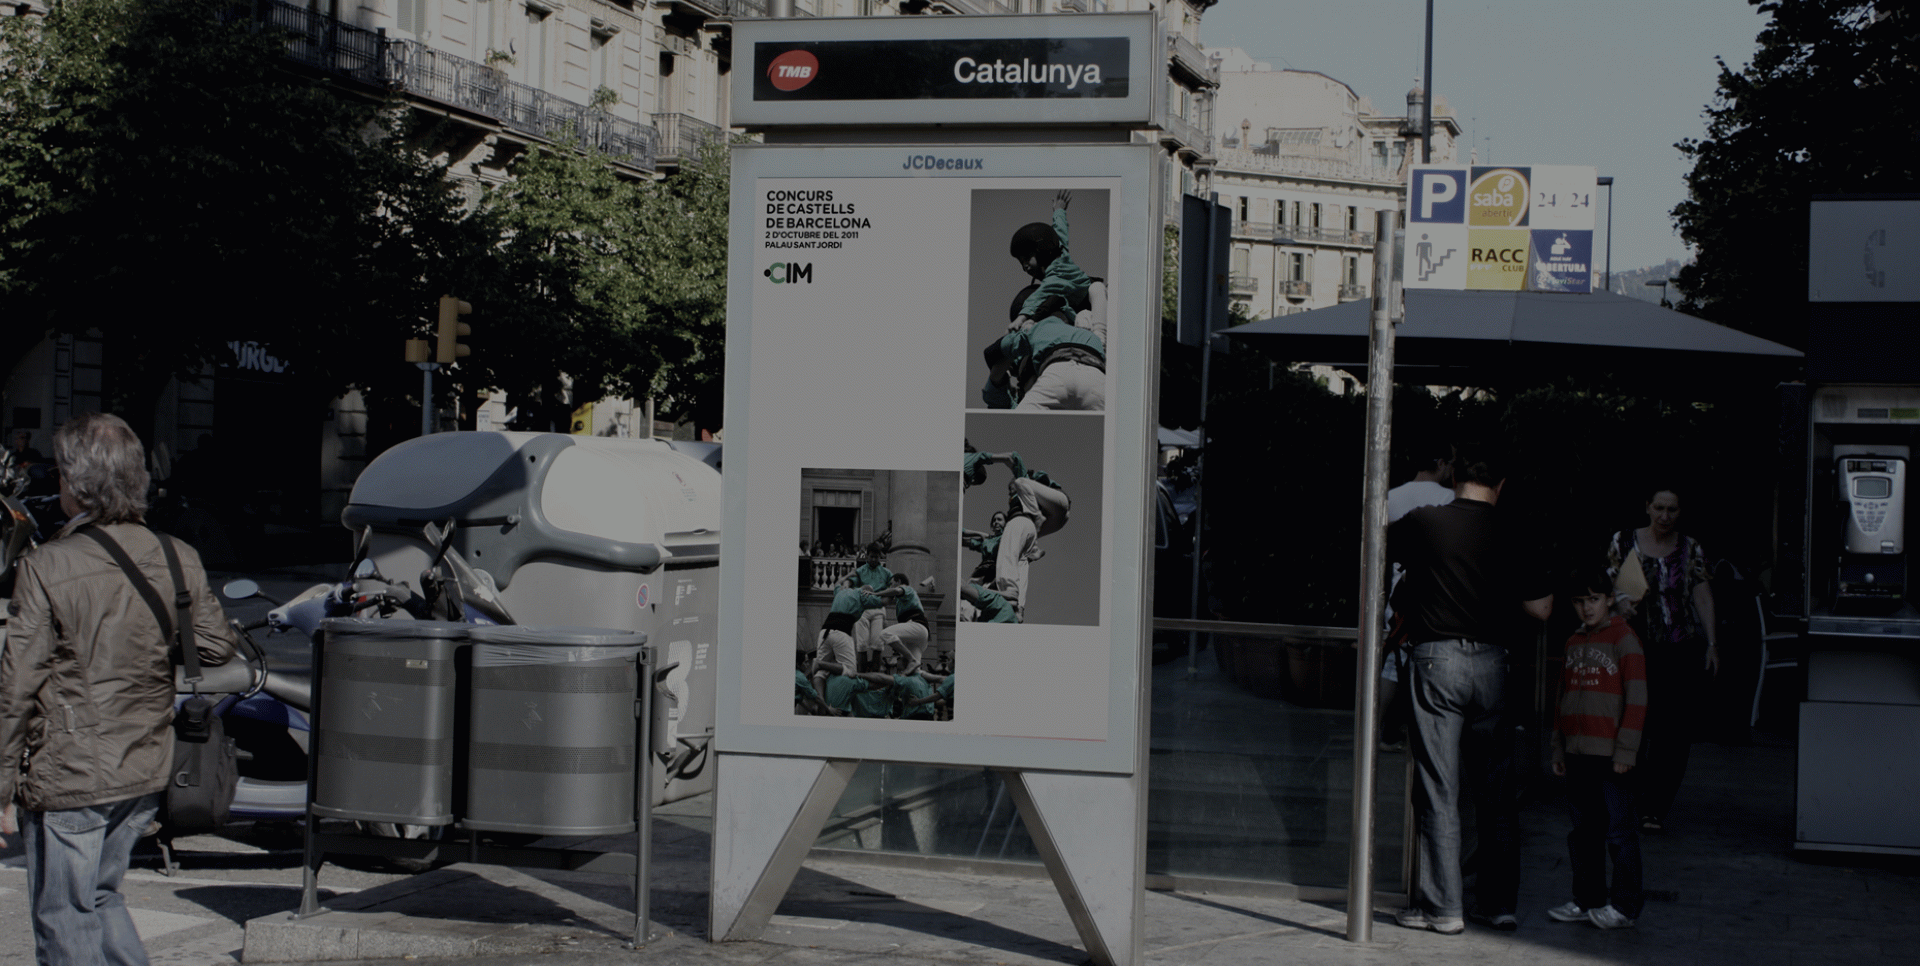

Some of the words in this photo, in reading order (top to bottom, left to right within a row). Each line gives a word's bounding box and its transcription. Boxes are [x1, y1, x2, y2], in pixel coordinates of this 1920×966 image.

[777, 63, 813, 79] TMB
[953, 57, 1101, 89] Catalunya
[902, 154, 983, 171] JCDecaux
[766, 190, 834, 202] CONCURS
[1421, 174, 1457, 218] P
[1473, 188, 1513, 207] saba
[766, 203, 785, 215] DE
[787, 203, 855, 215] CASTELLS
[765, 217, 785, 229] DE
[786, 217, 871, 229] BARCELONA
[765, 231, 771, 239] 2
[772, 231, 821, 239] D'OCTUBRE
[823, 231, 839, 239] DEL
[841, 231, 859, 239] 2011
[765, 241, 793, 249] PALAU
[793, 241, 816, 249] SANT
[816, 241, 842, 249] JORDI
[1471, 248, 1524, 263] RACC
[764, 262, 813, 284] CIM
